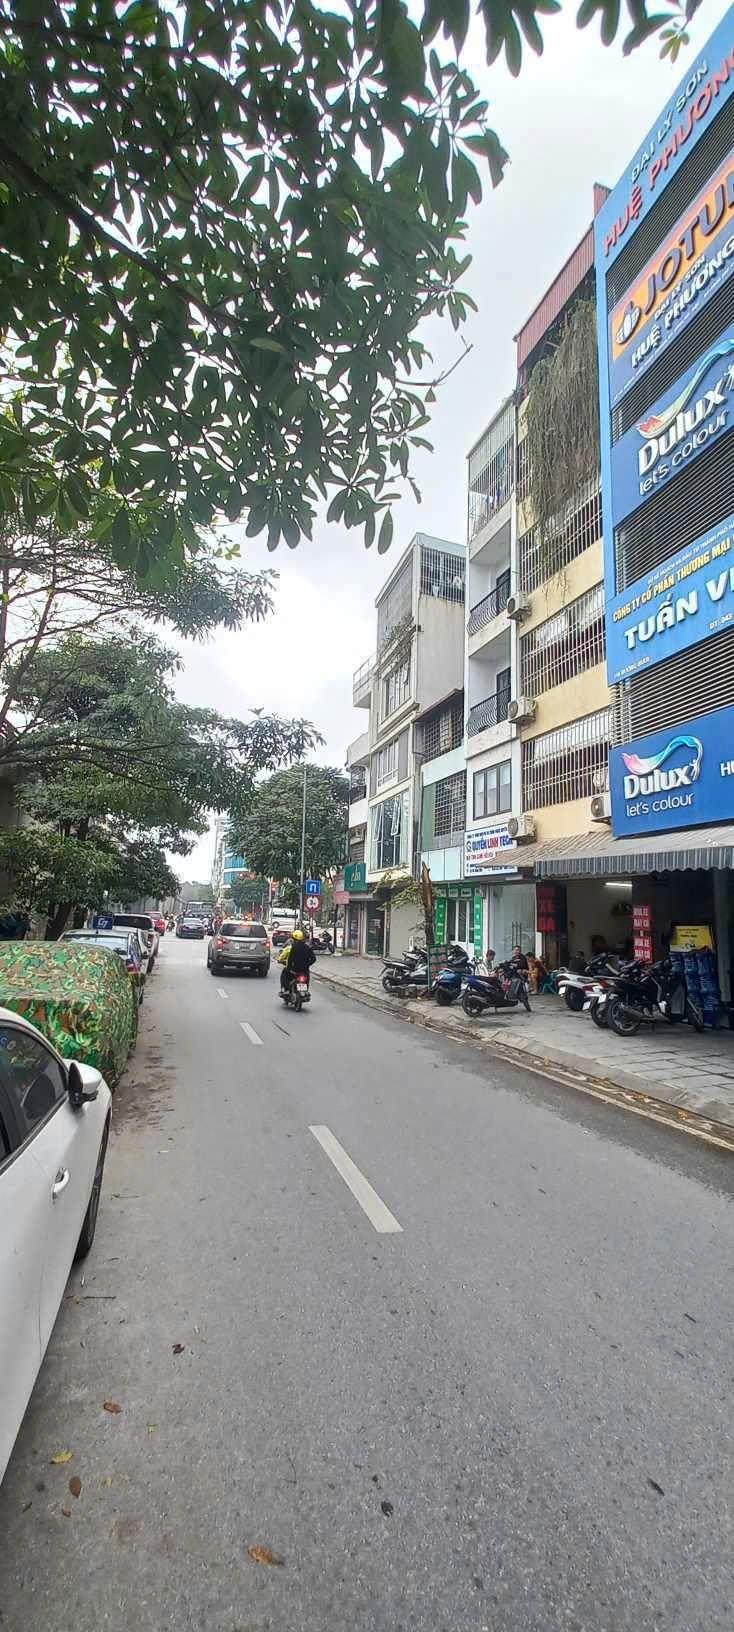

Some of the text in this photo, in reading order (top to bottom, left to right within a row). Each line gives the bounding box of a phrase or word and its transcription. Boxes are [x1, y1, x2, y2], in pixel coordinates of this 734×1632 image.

[604, 184, 643, 256] HUỆ
[631, 324, 661, 369] HUỆ
[638, 378, 729, 477] Dulux
[639, 410, 730, 496] let's colour
[613, 600, 632, 623] CÔNG
[631, 595, 642, 612] TY
[675, 552, 710, 583] THƯƠNG
[711, 538, 732, 561] MẠI
[624, 593, 699, 651] TUẤN
[624, 764, 693, 800] Dulux
[626, 792, 695, 817] let's colour
